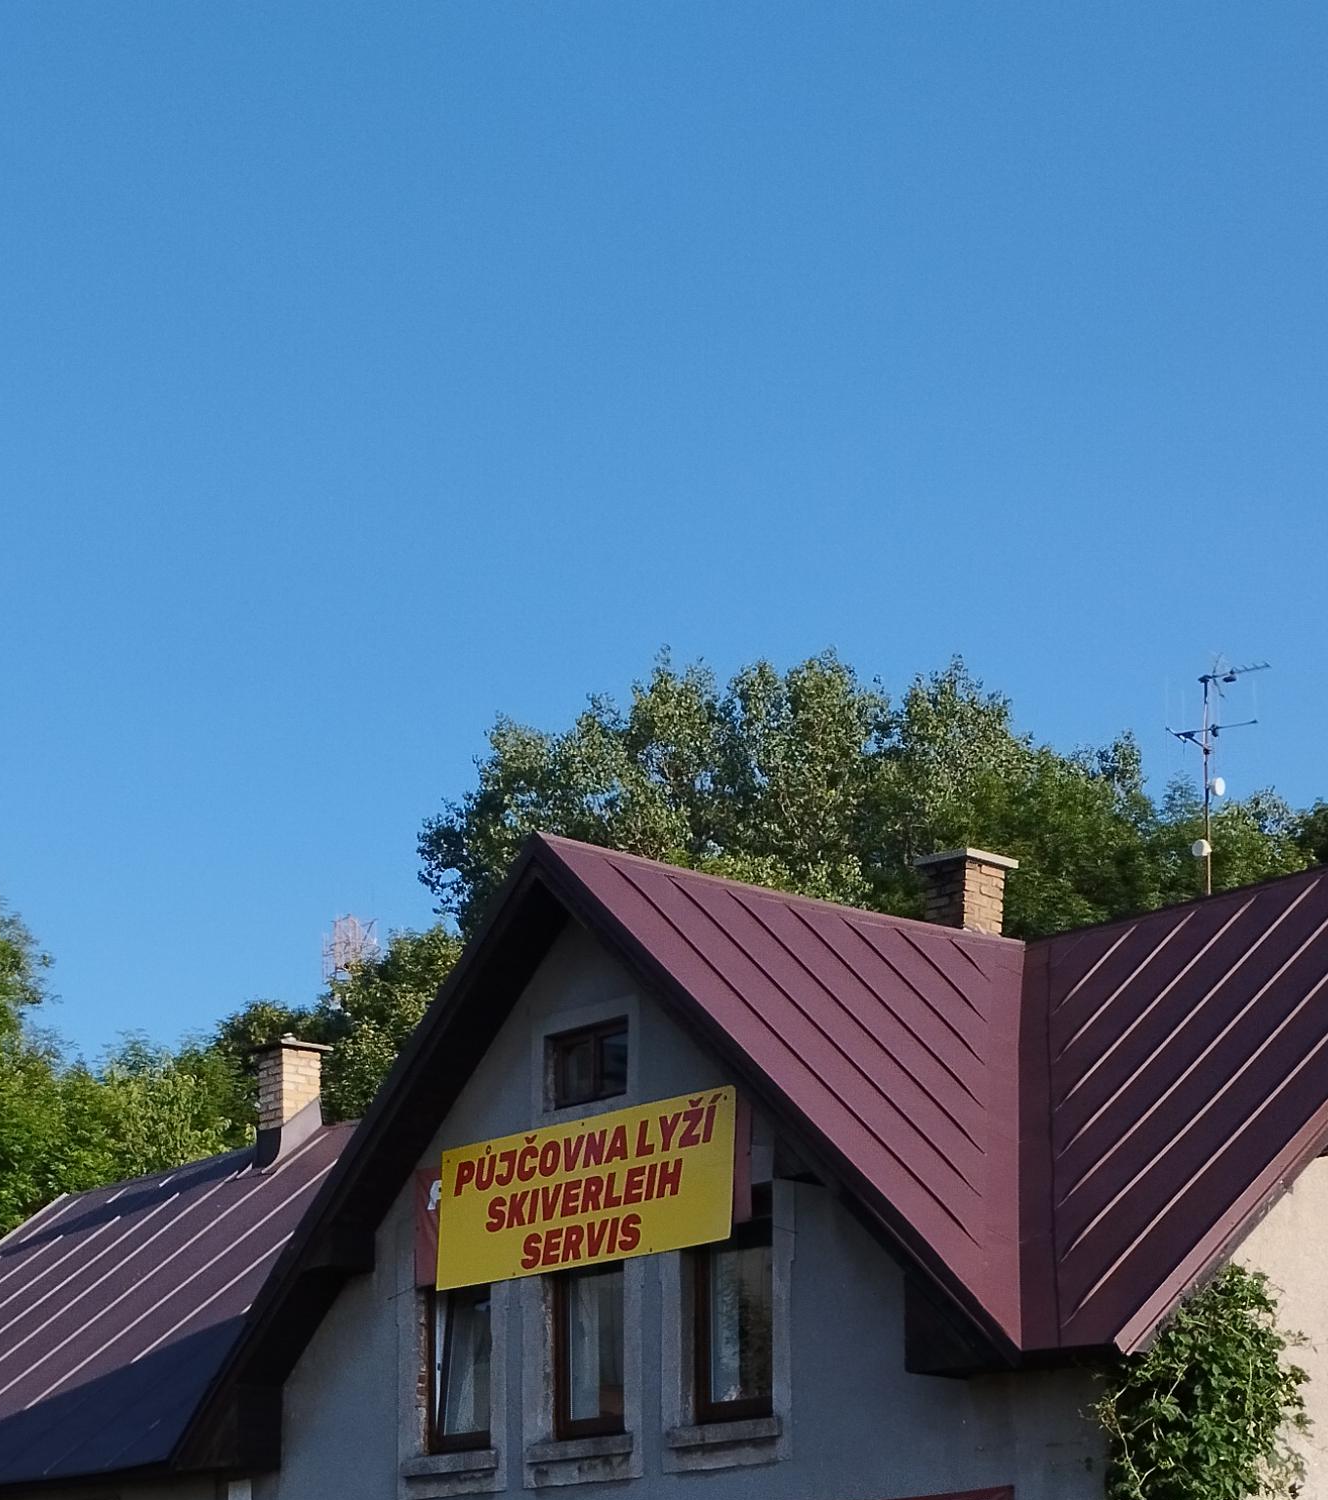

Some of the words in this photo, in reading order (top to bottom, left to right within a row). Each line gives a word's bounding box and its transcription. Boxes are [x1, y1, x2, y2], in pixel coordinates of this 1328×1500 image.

[453, 1126, 628, 1197] PŮJČOVNA
[635, 1094, 723, 1158] LYŽÍ
[485, 1158, 683, 1232] SKIVERLEIH
[520, 1213, 642, 1270] SERVIS
